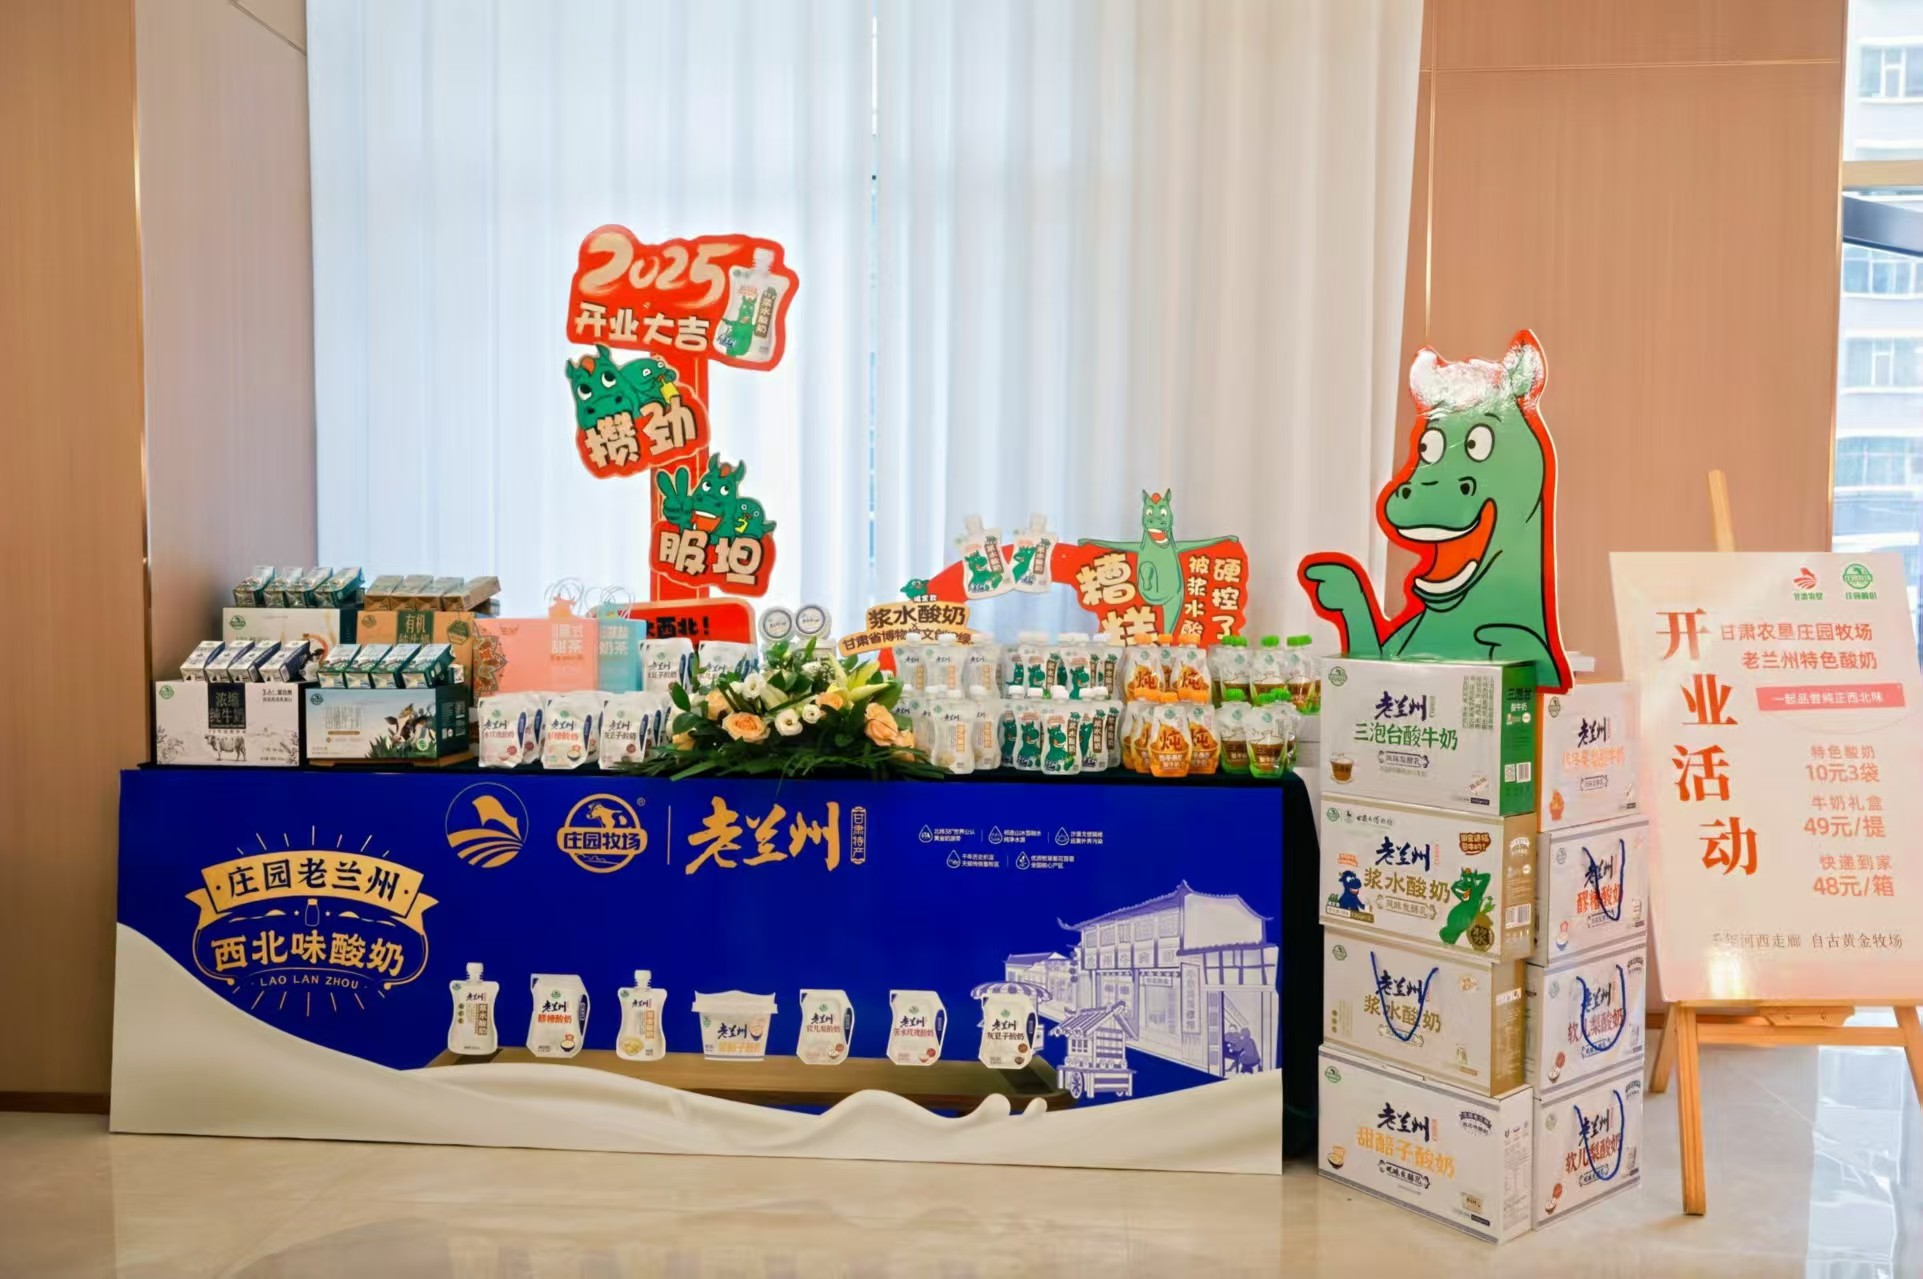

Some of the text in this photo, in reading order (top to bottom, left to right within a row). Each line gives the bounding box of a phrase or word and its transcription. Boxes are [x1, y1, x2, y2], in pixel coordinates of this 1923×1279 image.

[579, 232, 742, 310] 2025
[575, 301, 709, 351] 开业大吉
[584, 396, 697, 468] 攒劲
[1076, 553, 1160, 646] 糟糕
[1211, 558, 1241, 641] 硬控了
[405, 613, 426, 633] 有机
[868, 604, 966, 630] 浆水酸奶
[1721, 623, 1873, 641] 甘肃农垦庄园牧场
[1743, 652, 1878, 670] 老兰州特色酸奶
[1374, 691, 1428, 722] 老兰州
[1353, 722, 1458, 752] 三泡台酸牛奶
[1811, 745, 1875, 760] 特色酸奶
[1807, 764, 1880, 784] 10元3袋
[1812, 795, 1883, 811] 牛奶礼盒
[563, 831, 641, 850] 庄园牧场
[685, 796, 840, 875] 老兰州
[1804, 816, 1886, 838] 49元/提
[1375, 836, 1430, 872] 老兰州
[1819, 854, 1893, 871] 快递到家
[227, 857, 400, 902] 庄园老兰州
[1363, 867, 1450, 904] 浆水酸奶
[1813, 874, 1895, 897] 48元/箱
[210, 929, 404, 977] 西北味酸奶
[1811, 932, 1903, 949] 自古黄金牧场
[260, 974, 359, 990] LAO LAN ZHOU
[1375, 969, 1424, 1003] 老兰州
[1363, 994, 1441, 1033] 浆水酸奶
[717, 1022, 748, 1040] 老兰州
[1377, 1102, 1430, 1142] 老兰州
